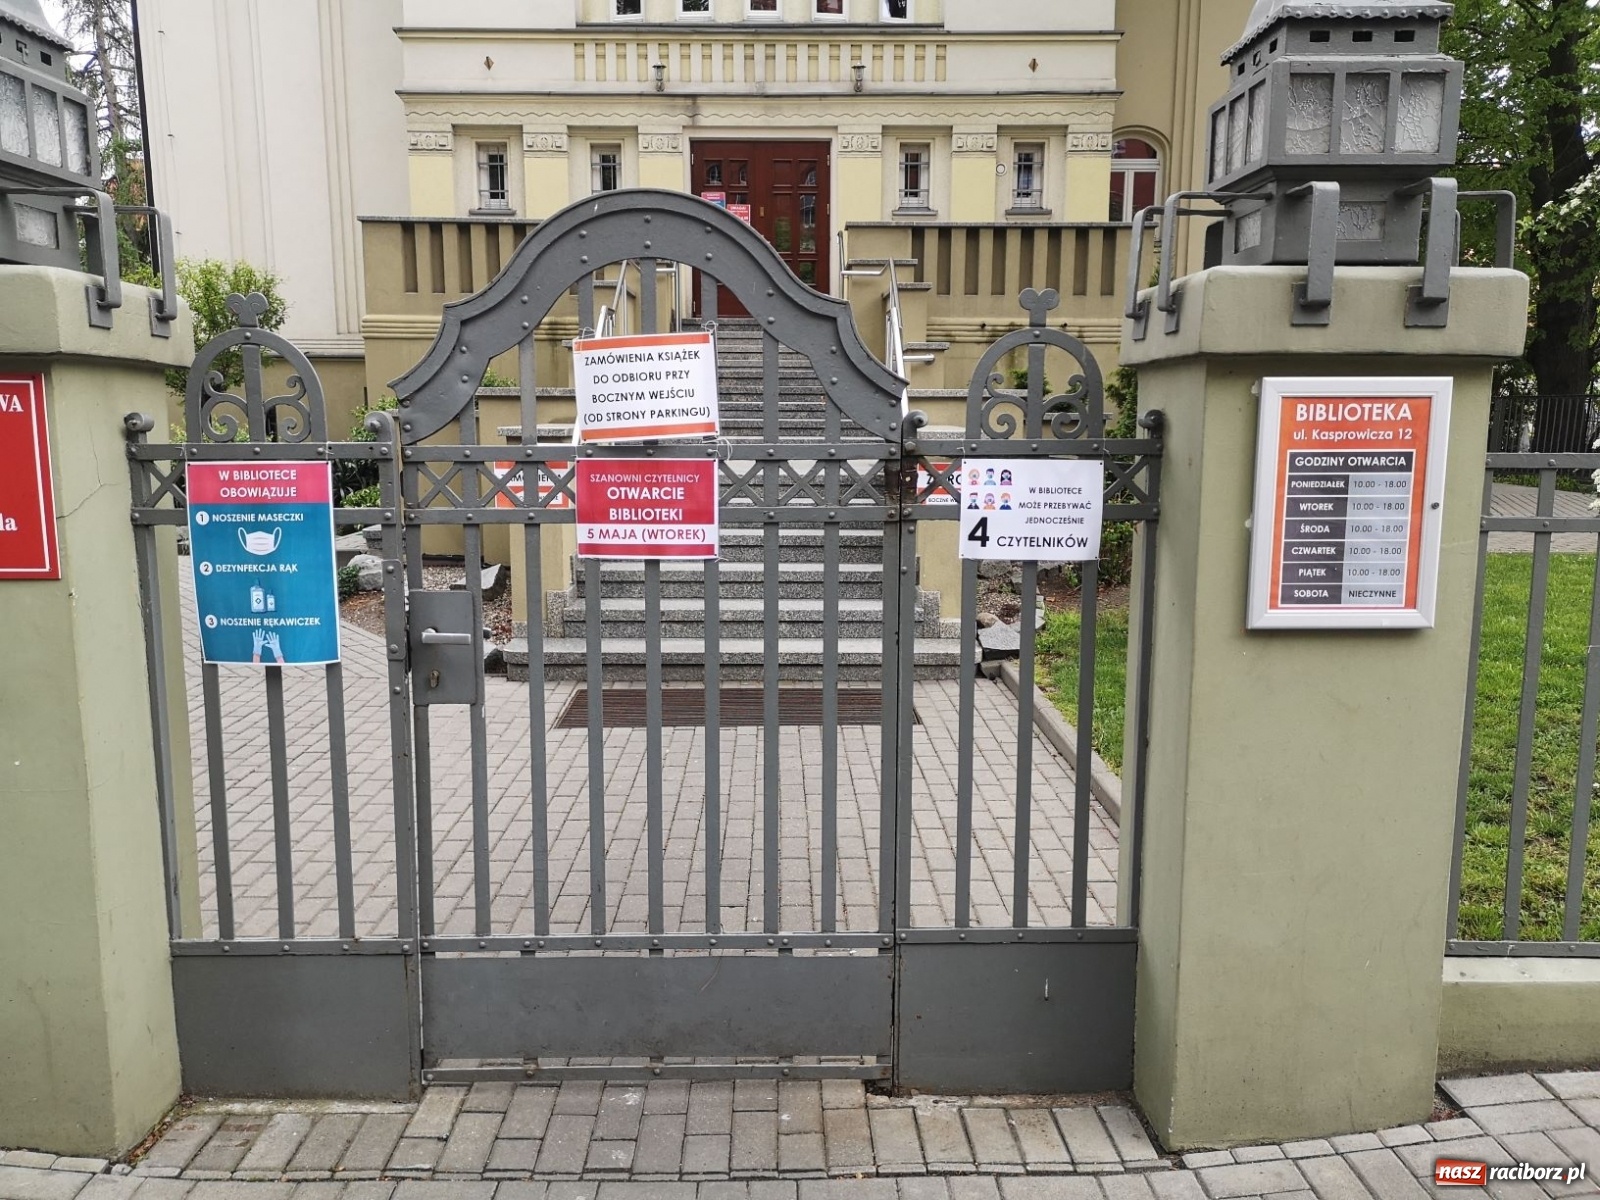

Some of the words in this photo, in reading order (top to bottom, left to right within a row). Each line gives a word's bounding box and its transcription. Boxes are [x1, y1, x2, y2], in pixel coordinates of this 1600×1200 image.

[585, 351, 654, 366] ZAMÓWIENIA
[658, 350, 700, 362] KSIĄŻEK
[593, 374, 609, 384] DO
[612, 372, 662, 383] ODBIORU
[665, 370, 690, 380] PRZY
[592, 391, 645, 403] BOCZNYM
[649, 389, 695, 400] WEJŚCIU
[584, 412, 602, 425] (OD
[606, 410, 647, 422] STRONY
[650, 407, 710, 419] PARKINGU)
[1296, 403, 1412, 421] BIBLIOTEKA
[1293, 429, 1307, 440] ul.
[1312, 428, 1393, 442] Kasprowicza
[1398, 428, 1413, 440] 12
[1295, 457, 1345, 467] GODZINY
[1348, 457, 1406, 466] OTWARCIA
[219, 470, 230, 481] W
[234, 469, 297, 480] BIBLIOTECE
[590, 474, 642, 483] SZANOWNI
[644, 474, 700, 483] CZYTELNICY
[1291, 480, 1345, 489] PONIEDZIAŁEK
[220, 487, 297, 499] OBOWIĄZUJE
[607, 487, 685, 500] OTWARCIE
[1044, 500, 1092, 510] PRZEBYWAĆ
[1299, 503, 1334, 511] WTOREK
[212, 514, 256, 522] NOSZENIE
[258, 513, 304, 522] MASECZKI
[609, 508, 683, 521] BIBLIOTEKI
[1025, 515, 1084, 524] JEDNOCZEŚNIE
[968, 517, 990, 547] 4
[997, 534, 1088, 548] CZYTELNIKÓW
[1300, 524, 1330, 533] ŚRODA
[1351, 525, 1372, 533] 10.00
[1382, 525, 1403, 533] 18.00
[587, 529, 594, 539] 5
[599, 529, 637, 539] MAJA
[642, 528, 706, 542] (WTOREK)
[1291, 547, 1336, 555] CZWARTEK
[1349, 547, 1371, 555] 10.00
[1380, 547, 1402, 555] 18.00
[216, 564, 277, 573] DEZYNFEKCJA
[279, 564, 298, 574] RĄK
[1298, 569, 1326, 578] PIĄTEK
[1348, 569, 1369, 577] 10.00
[1379, 569, 1400, 577] 18.00
[1294, 590, 1328, 598] SOBOTA
[1348, 590, 1396, 598] NIECZYNNE
[220, 618, 261, 626] NOSZENIE
[264, 617, 321, 627] RĘKAWICZEK
